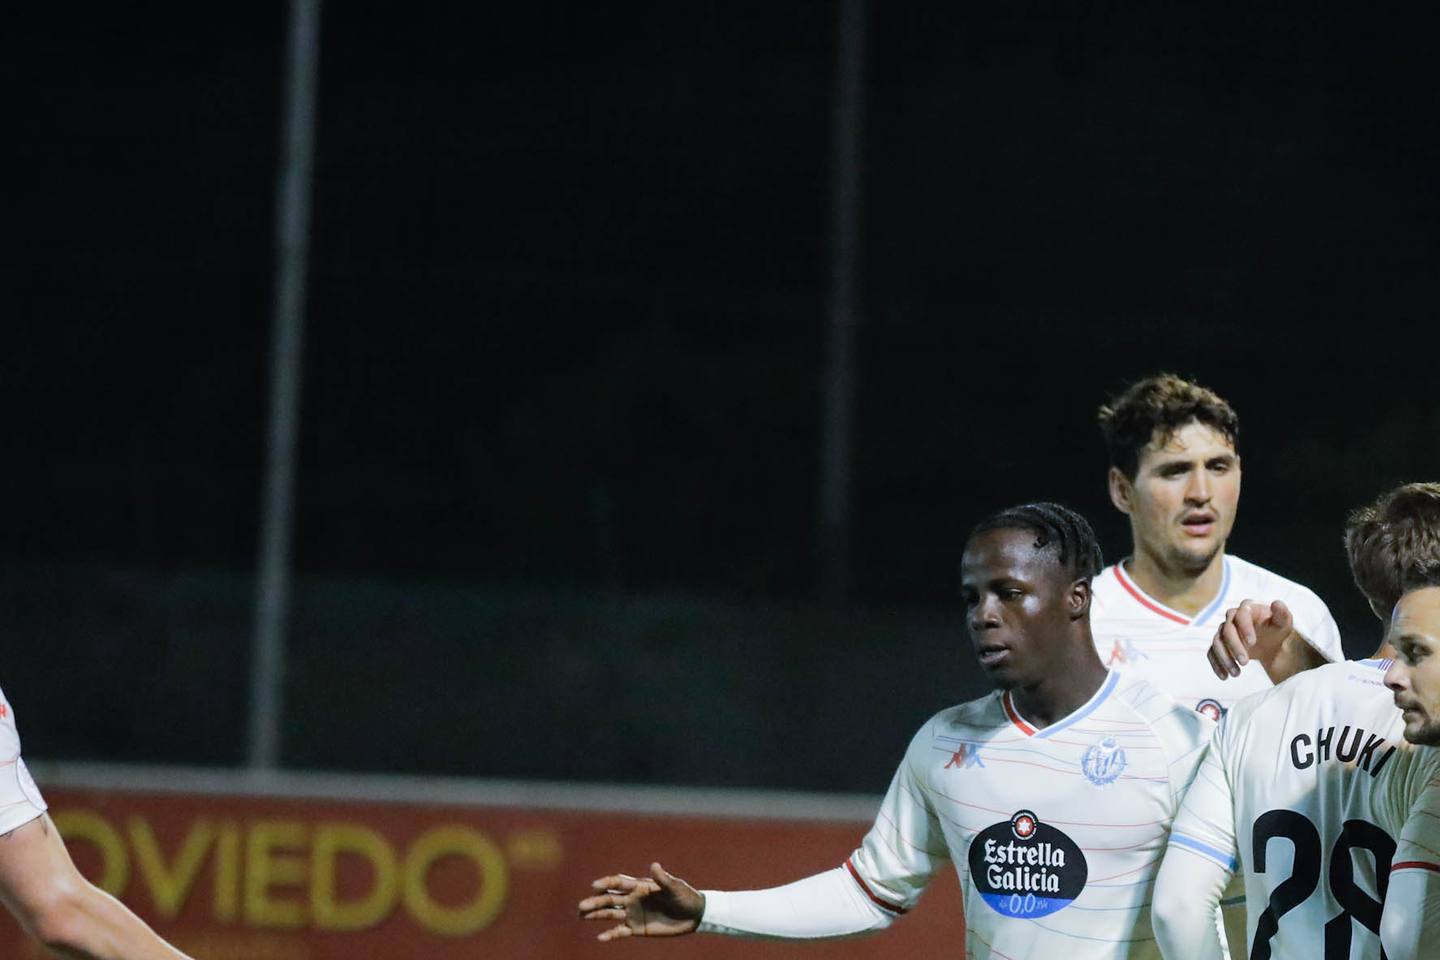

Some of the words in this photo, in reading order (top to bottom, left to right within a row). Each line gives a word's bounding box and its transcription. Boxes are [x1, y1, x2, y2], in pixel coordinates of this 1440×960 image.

[1290, 725, 1397, 778] CHUKI
[983, 838, 1066, 868] Estrella
[986, 863, 1061, 893] Galicia
